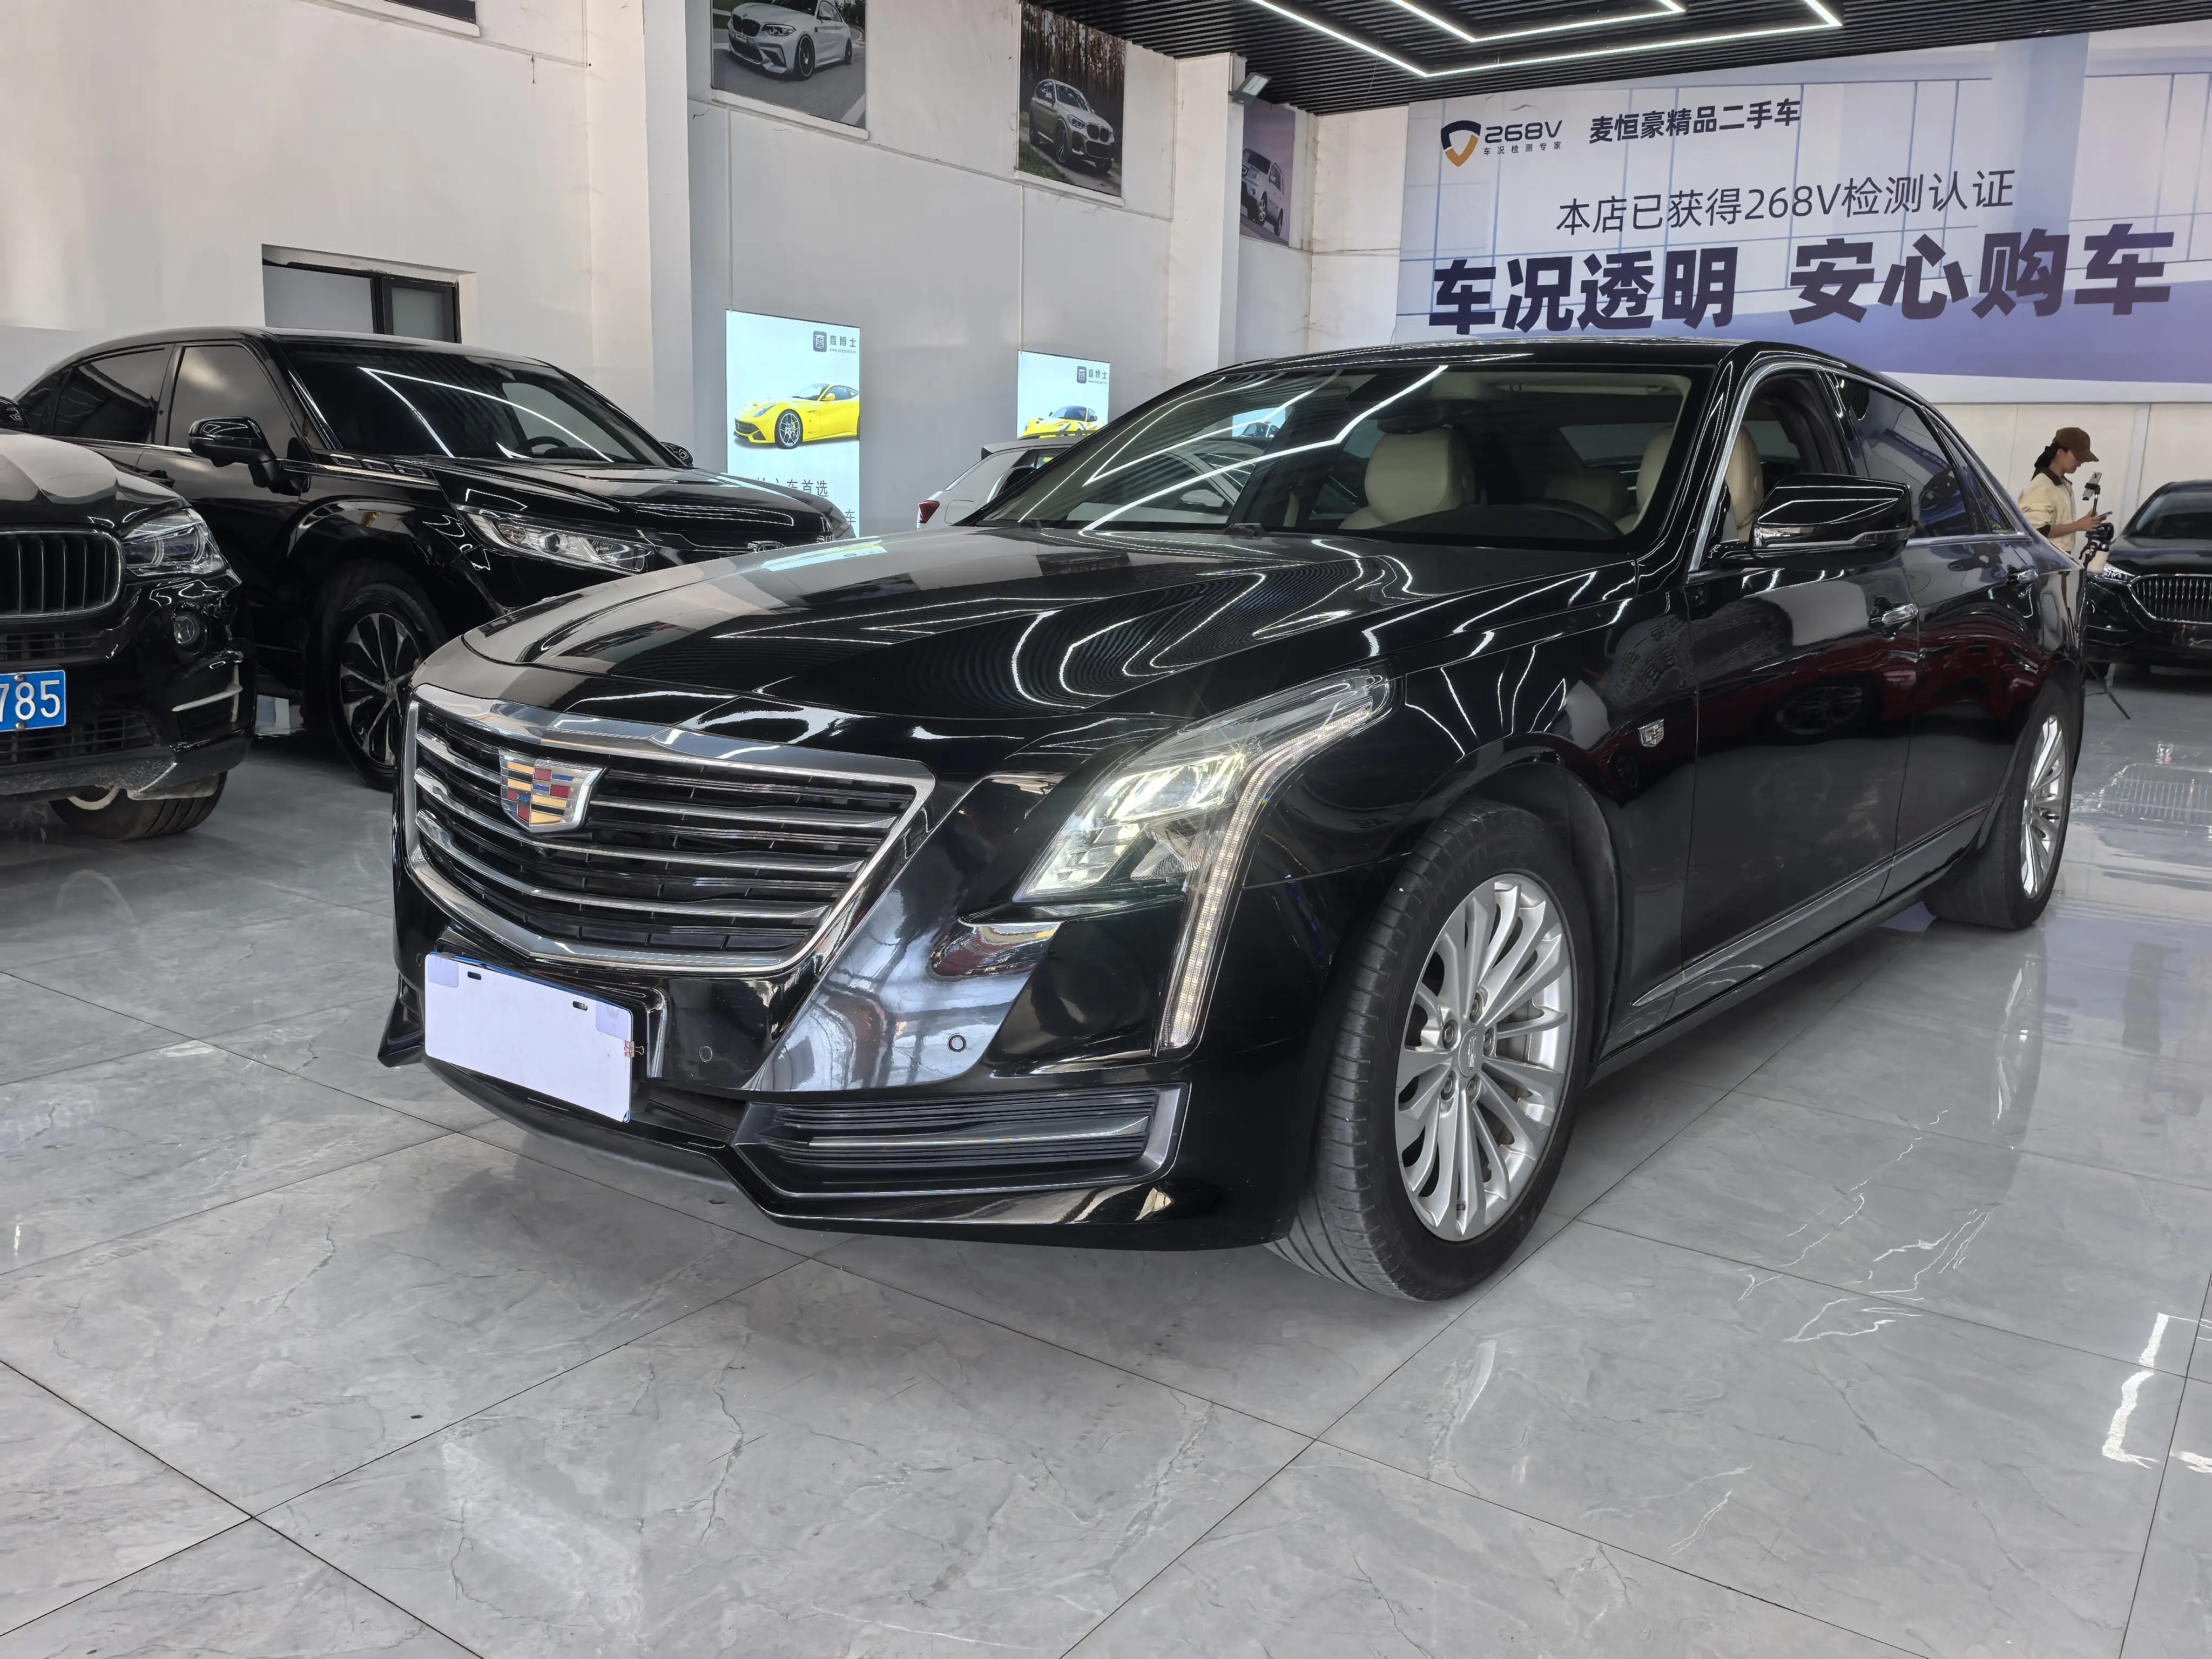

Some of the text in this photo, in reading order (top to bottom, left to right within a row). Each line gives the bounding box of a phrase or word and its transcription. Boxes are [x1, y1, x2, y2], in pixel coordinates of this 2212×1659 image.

[1485, 120, 1563, 144] 268V
[1589, 98, 1800, 144] 麦恒豪精品二手车
[1483, 141, 1561, 156] 车况检测专家
[1556, 170, 2015, 235] 本店已获得268V检测认证
[1429, 223, 2174, 335] 车况透明 安心购车
[830, 335, 857, 347] 查博士
